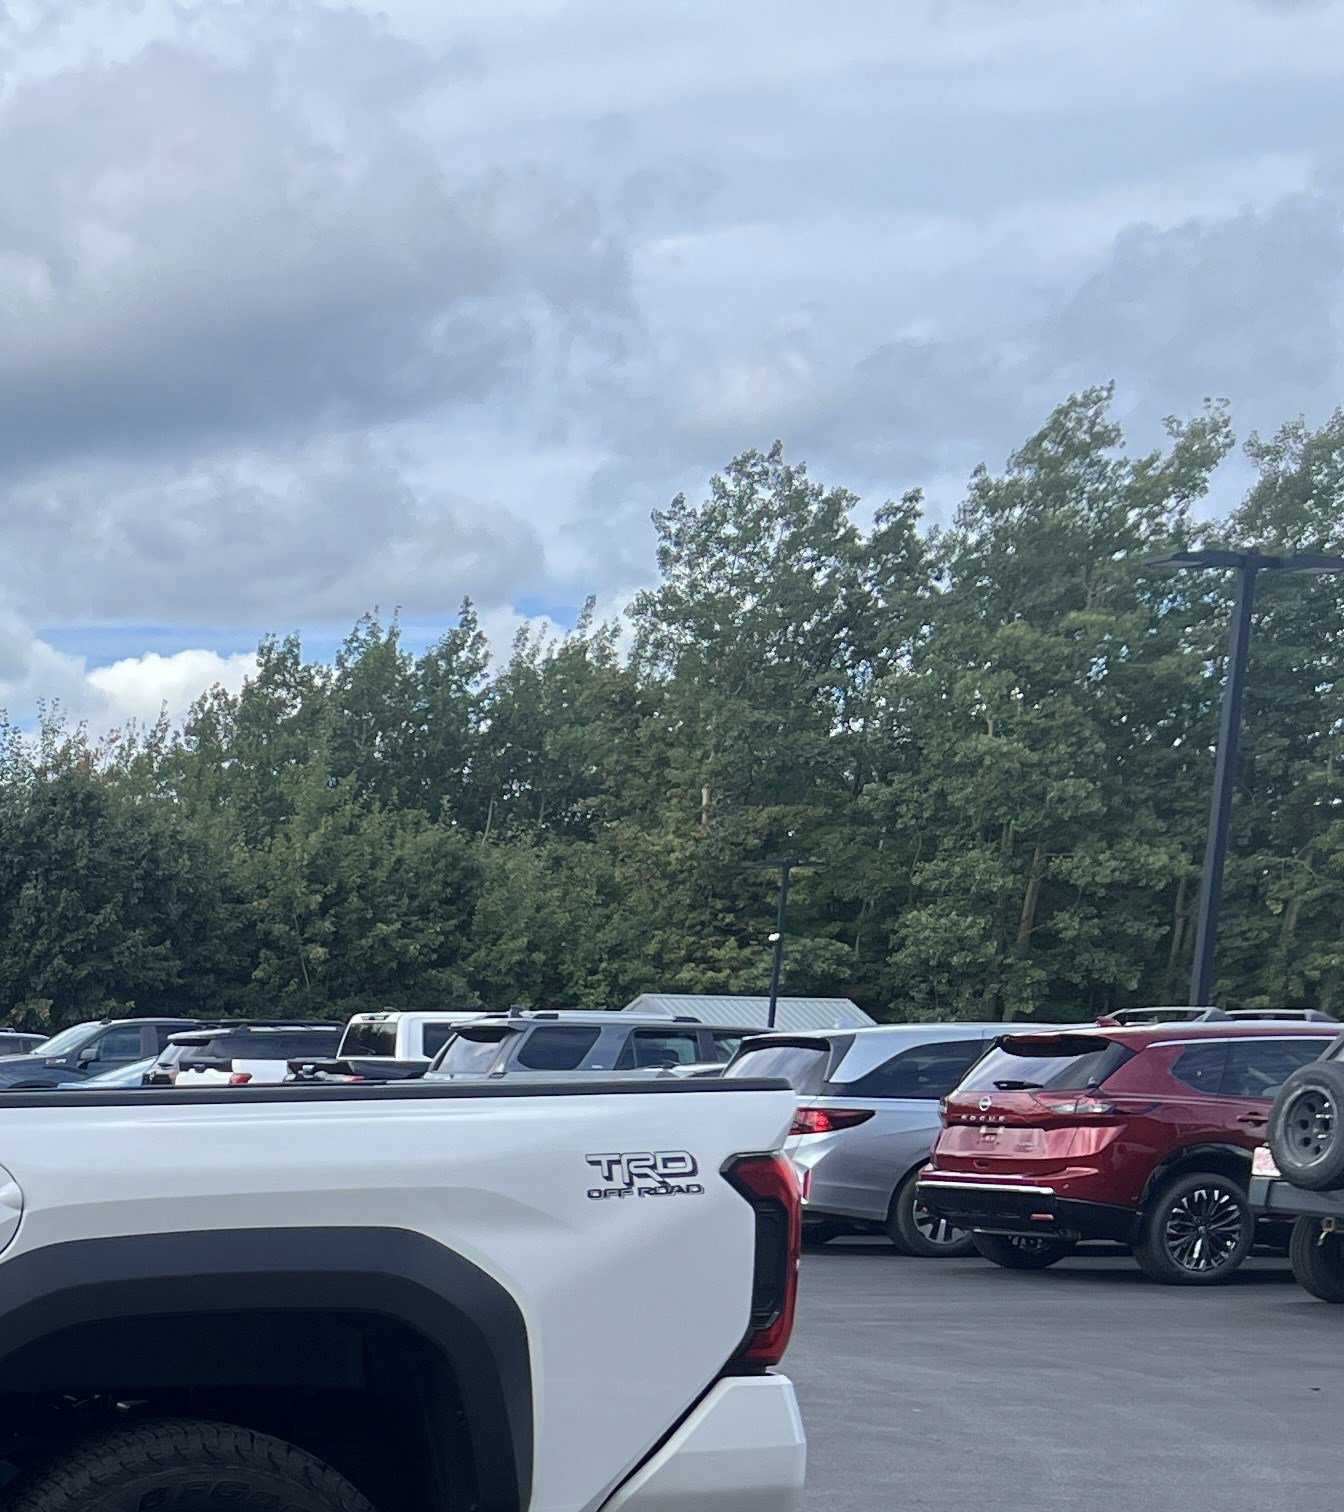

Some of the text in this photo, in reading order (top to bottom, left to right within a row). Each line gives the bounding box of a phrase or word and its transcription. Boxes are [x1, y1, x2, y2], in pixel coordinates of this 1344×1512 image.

[585, 1150, 698, 1188] TRD
[587, 1184, 705, 1200] OFF ROAD
